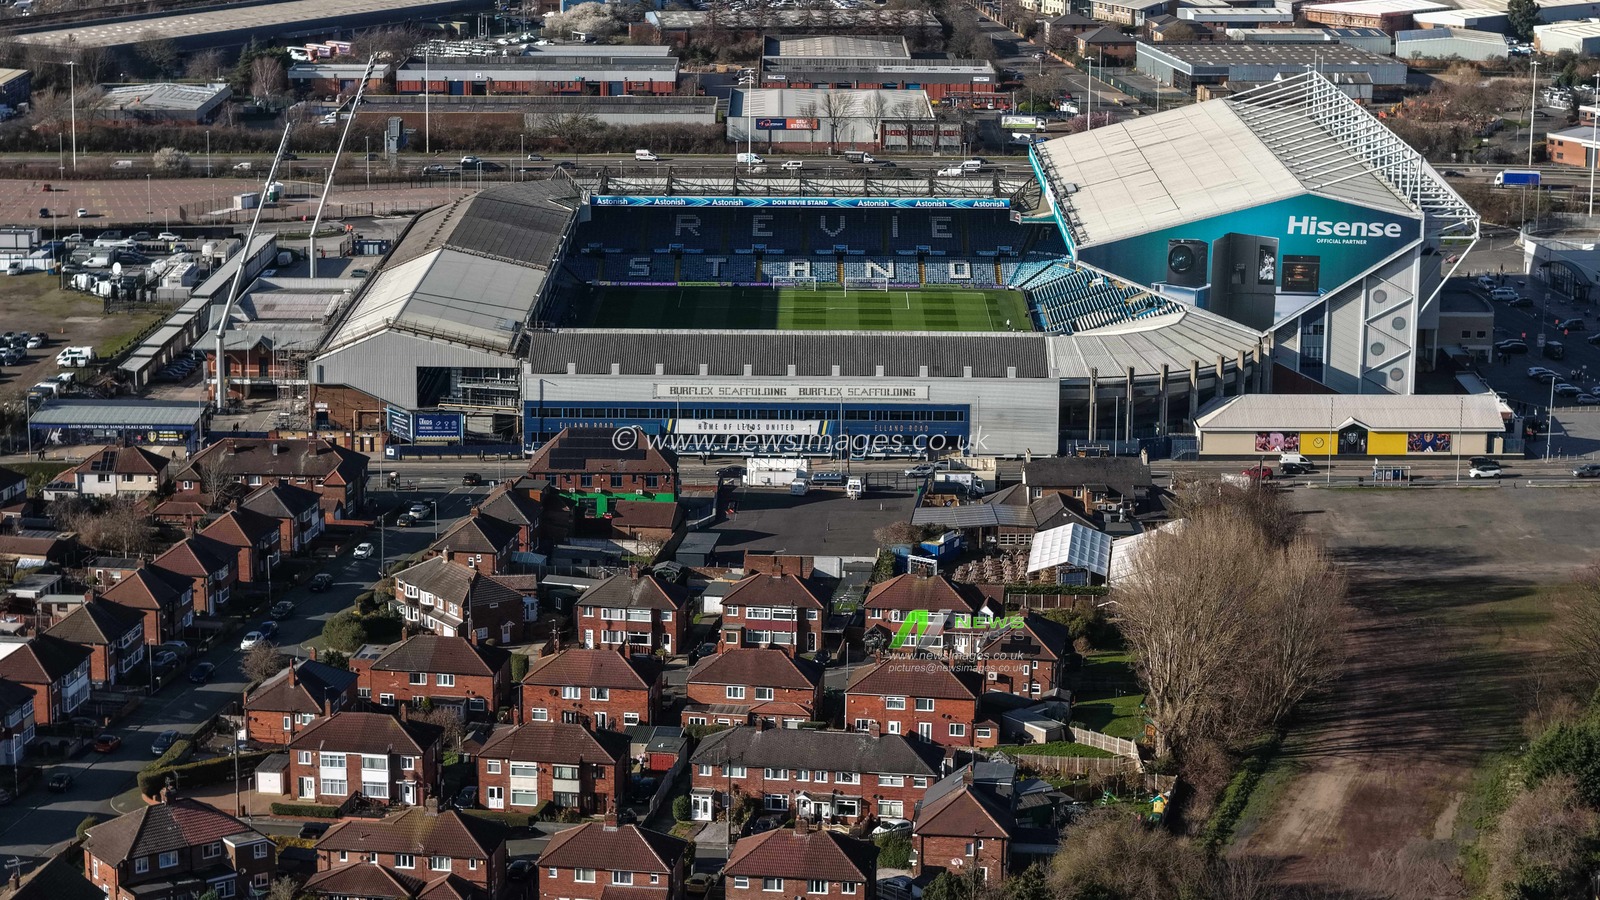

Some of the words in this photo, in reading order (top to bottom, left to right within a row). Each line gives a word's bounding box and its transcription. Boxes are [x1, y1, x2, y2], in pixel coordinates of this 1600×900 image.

[596, 198, 628, 206] Astonish
[654, 198, 686, 206] Astonish
[711, 198, 744, 206] Astonish
[857, 199, 889, 207] Astonish
[915, 199, 947, 207] Astonish
[973, 199, 1005, 208] Astonish
[1287, 215, 1402, 238] Hisense
[669, 386, 713, 396] BURFLEX
[718, 386, 787, 396] SCAFFOLDING
[798, 387, 842, 396] BURFLEX
[848, 388, 916, 397] SCAFFOLDING
[874, 424, 905, 432] ELLAND
